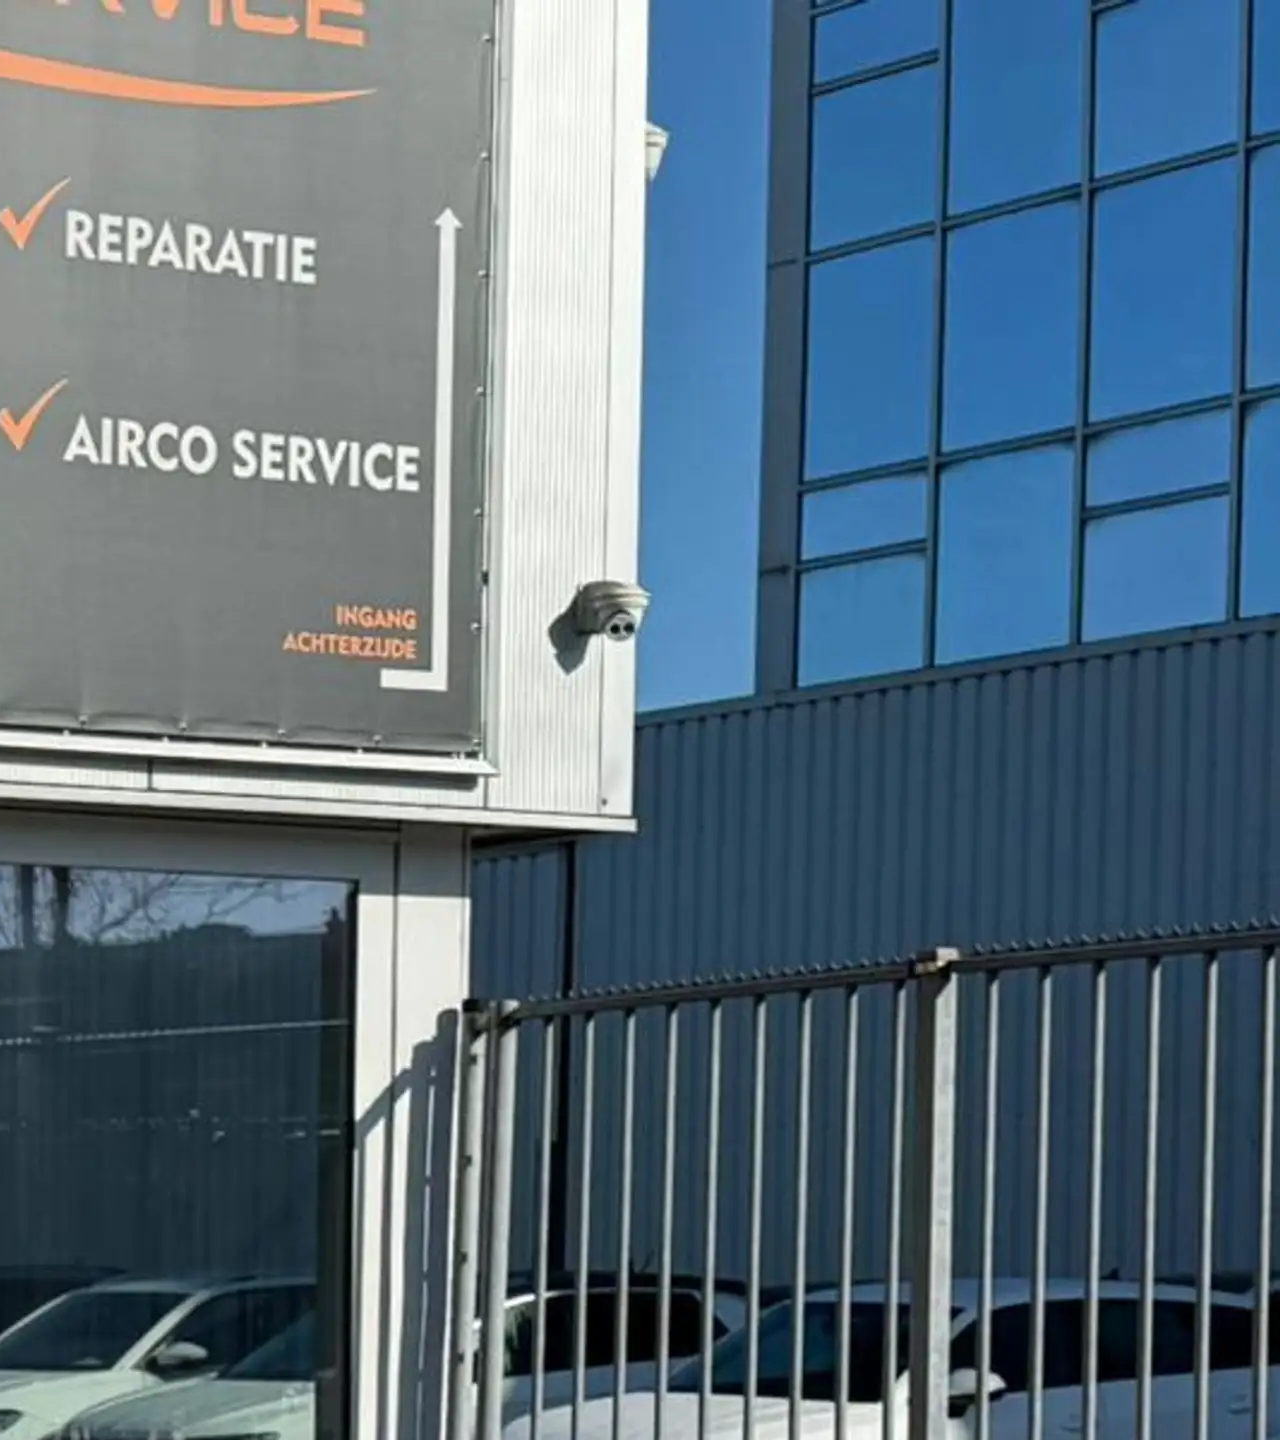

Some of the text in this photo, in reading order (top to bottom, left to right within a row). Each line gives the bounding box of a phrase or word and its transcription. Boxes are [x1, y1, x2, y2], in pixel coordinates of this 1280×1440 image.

[65, 209, 317, 284] REPARATIE
[62, 414, 420, 492] AIRCO SERVICE
[335, 604, 418, 630] INGANG
[281, 630, 418, 660] ACHTERZIJDE
